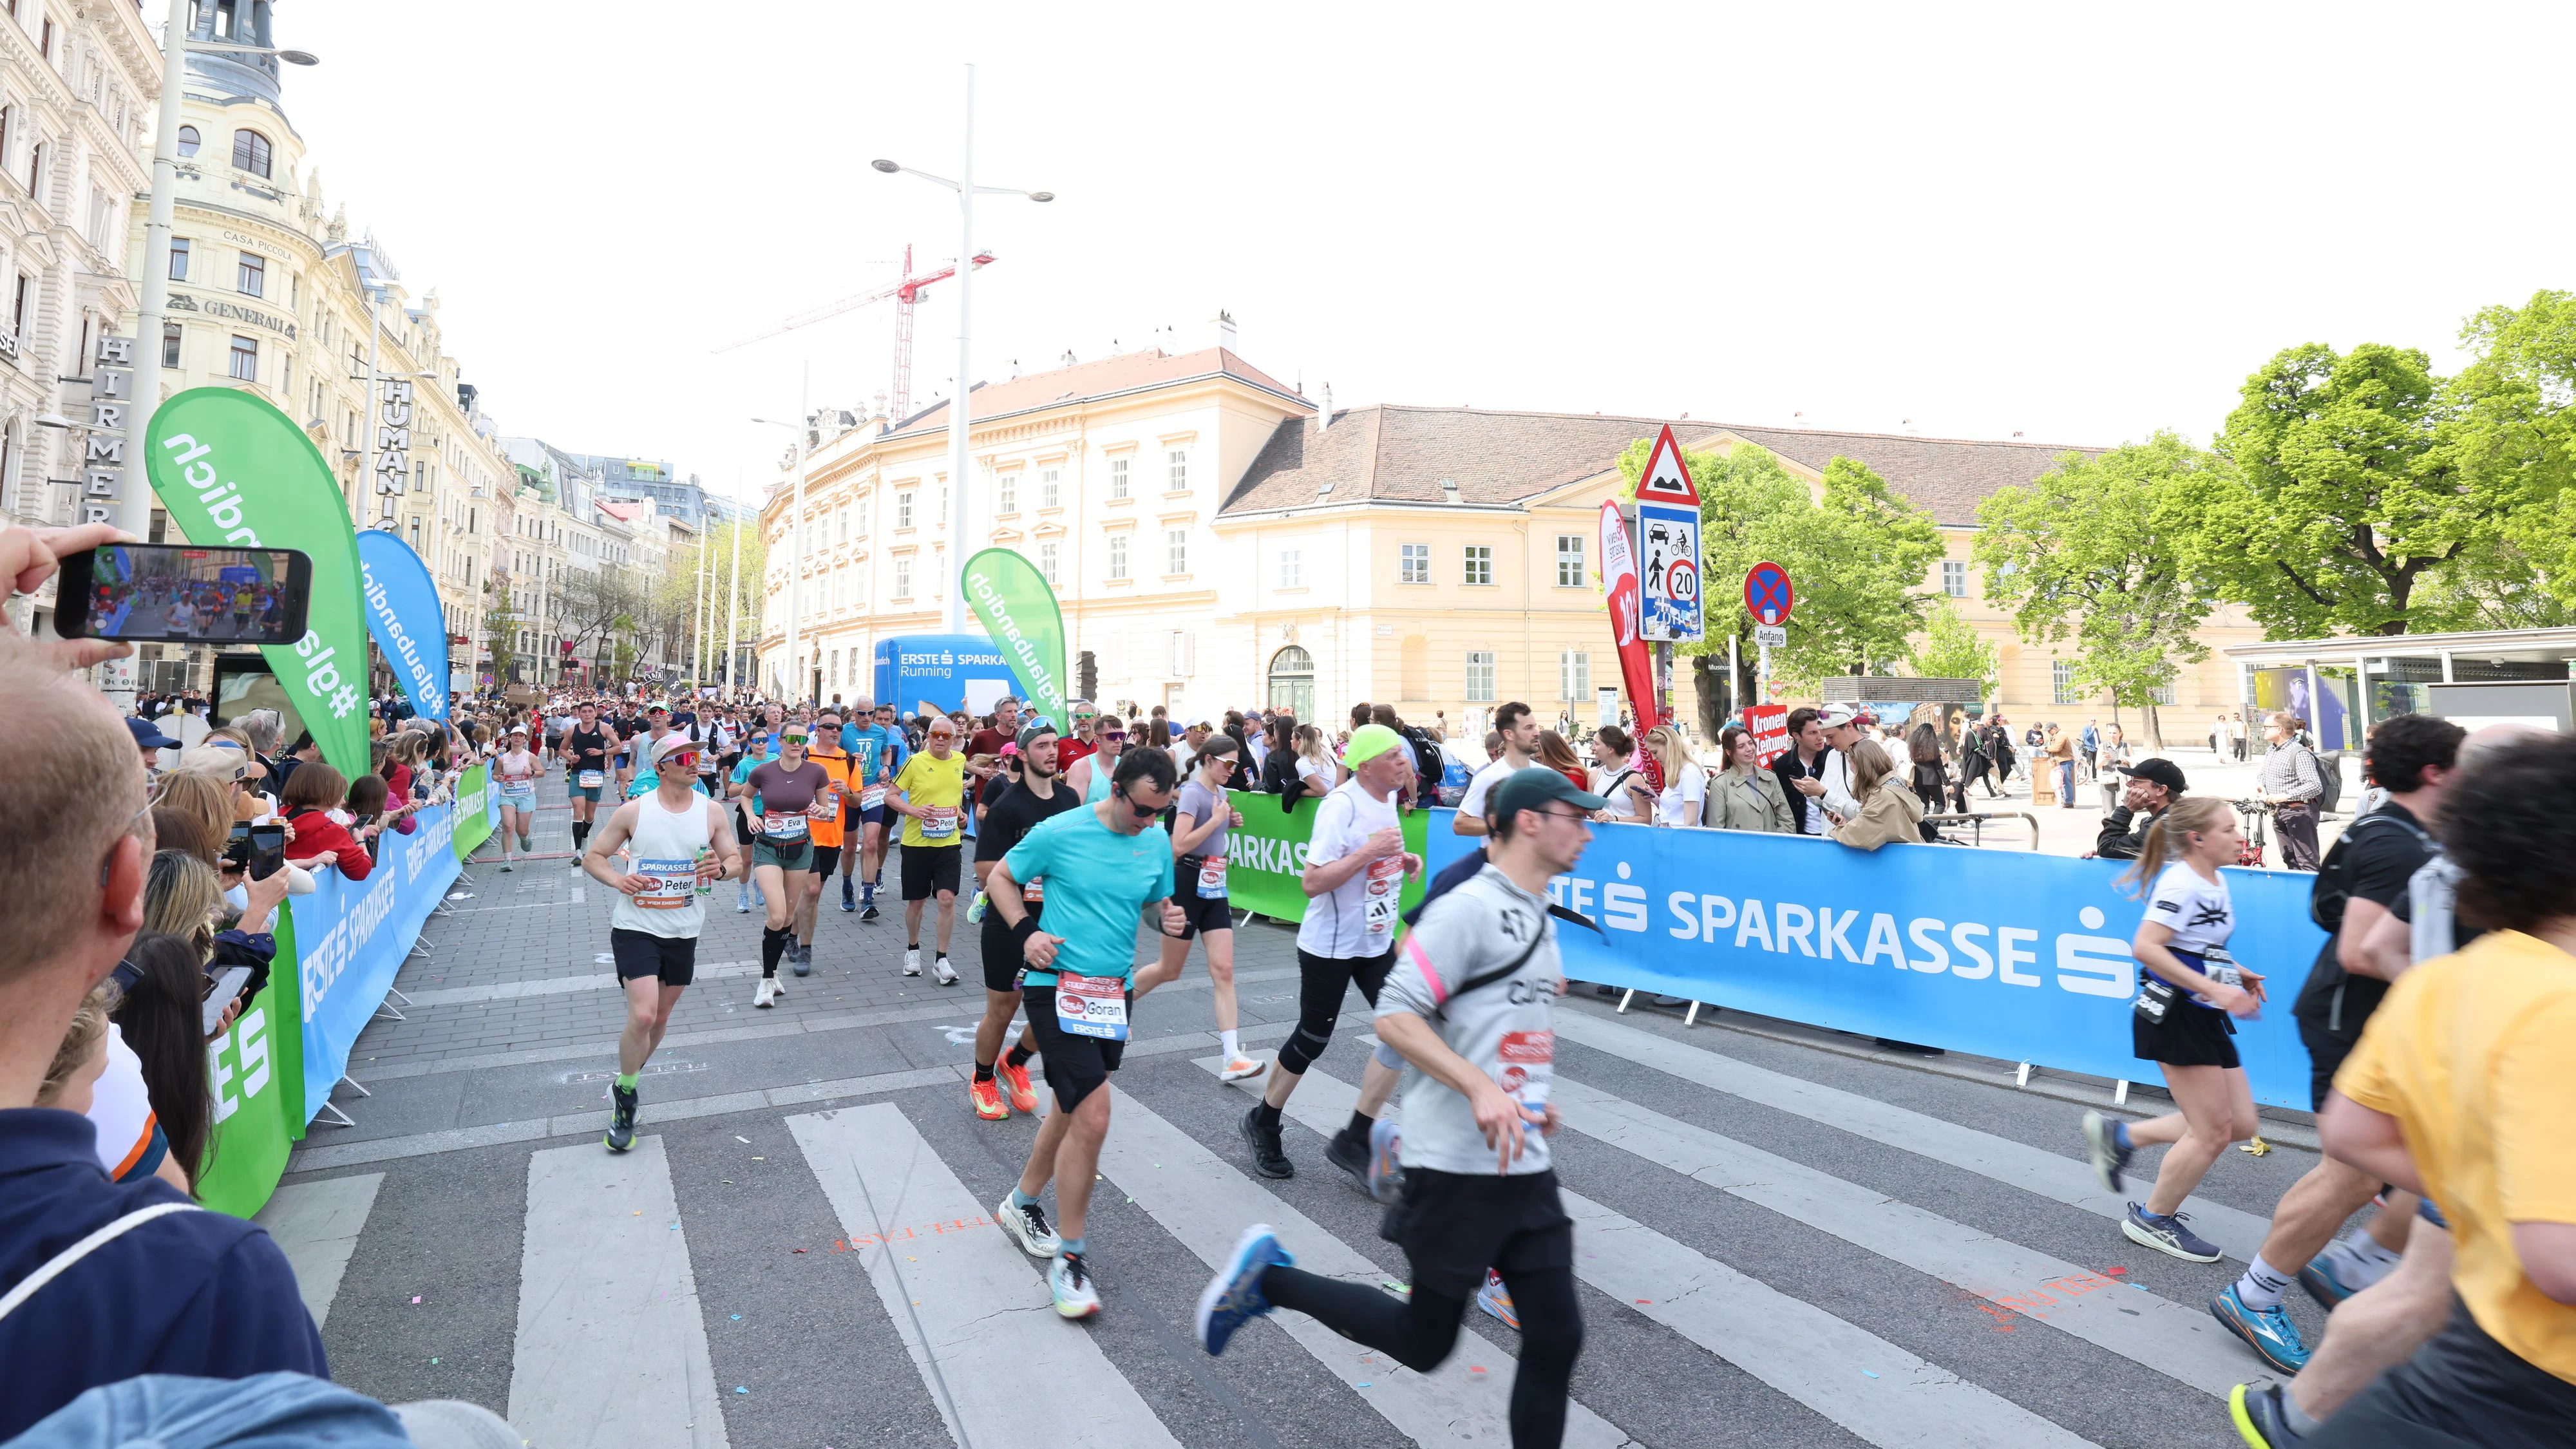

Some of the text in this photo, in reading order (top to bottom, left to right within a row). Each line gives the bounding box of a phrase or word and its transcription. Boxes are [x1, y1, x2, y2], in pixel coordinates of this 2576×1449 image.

[223, 231, 292, 261] CASA PICCOLA
[204, 299, 283, 333] GENERALI
[1676, 572, 1692, 595] 20
[1759, 630, 1783, 644] Anfang
[902, 653, 939, 665] ERSTE
[901, 665, 951, 679] Running
[1753, 712, 1787, 734] Kronen
[1754, 734, 1788, 756] Zeitung
[788, 819, 800, 827] Eva
[641, 863, 687, 871] SPARKASSE
[665, 880, 693, 890] Peter
[1668, 891, 2041, 988] SPARKASSE
[1086, 1001, 1121, 1016] Goran
[1072, 1023, 1104, 1037] ERSTE
